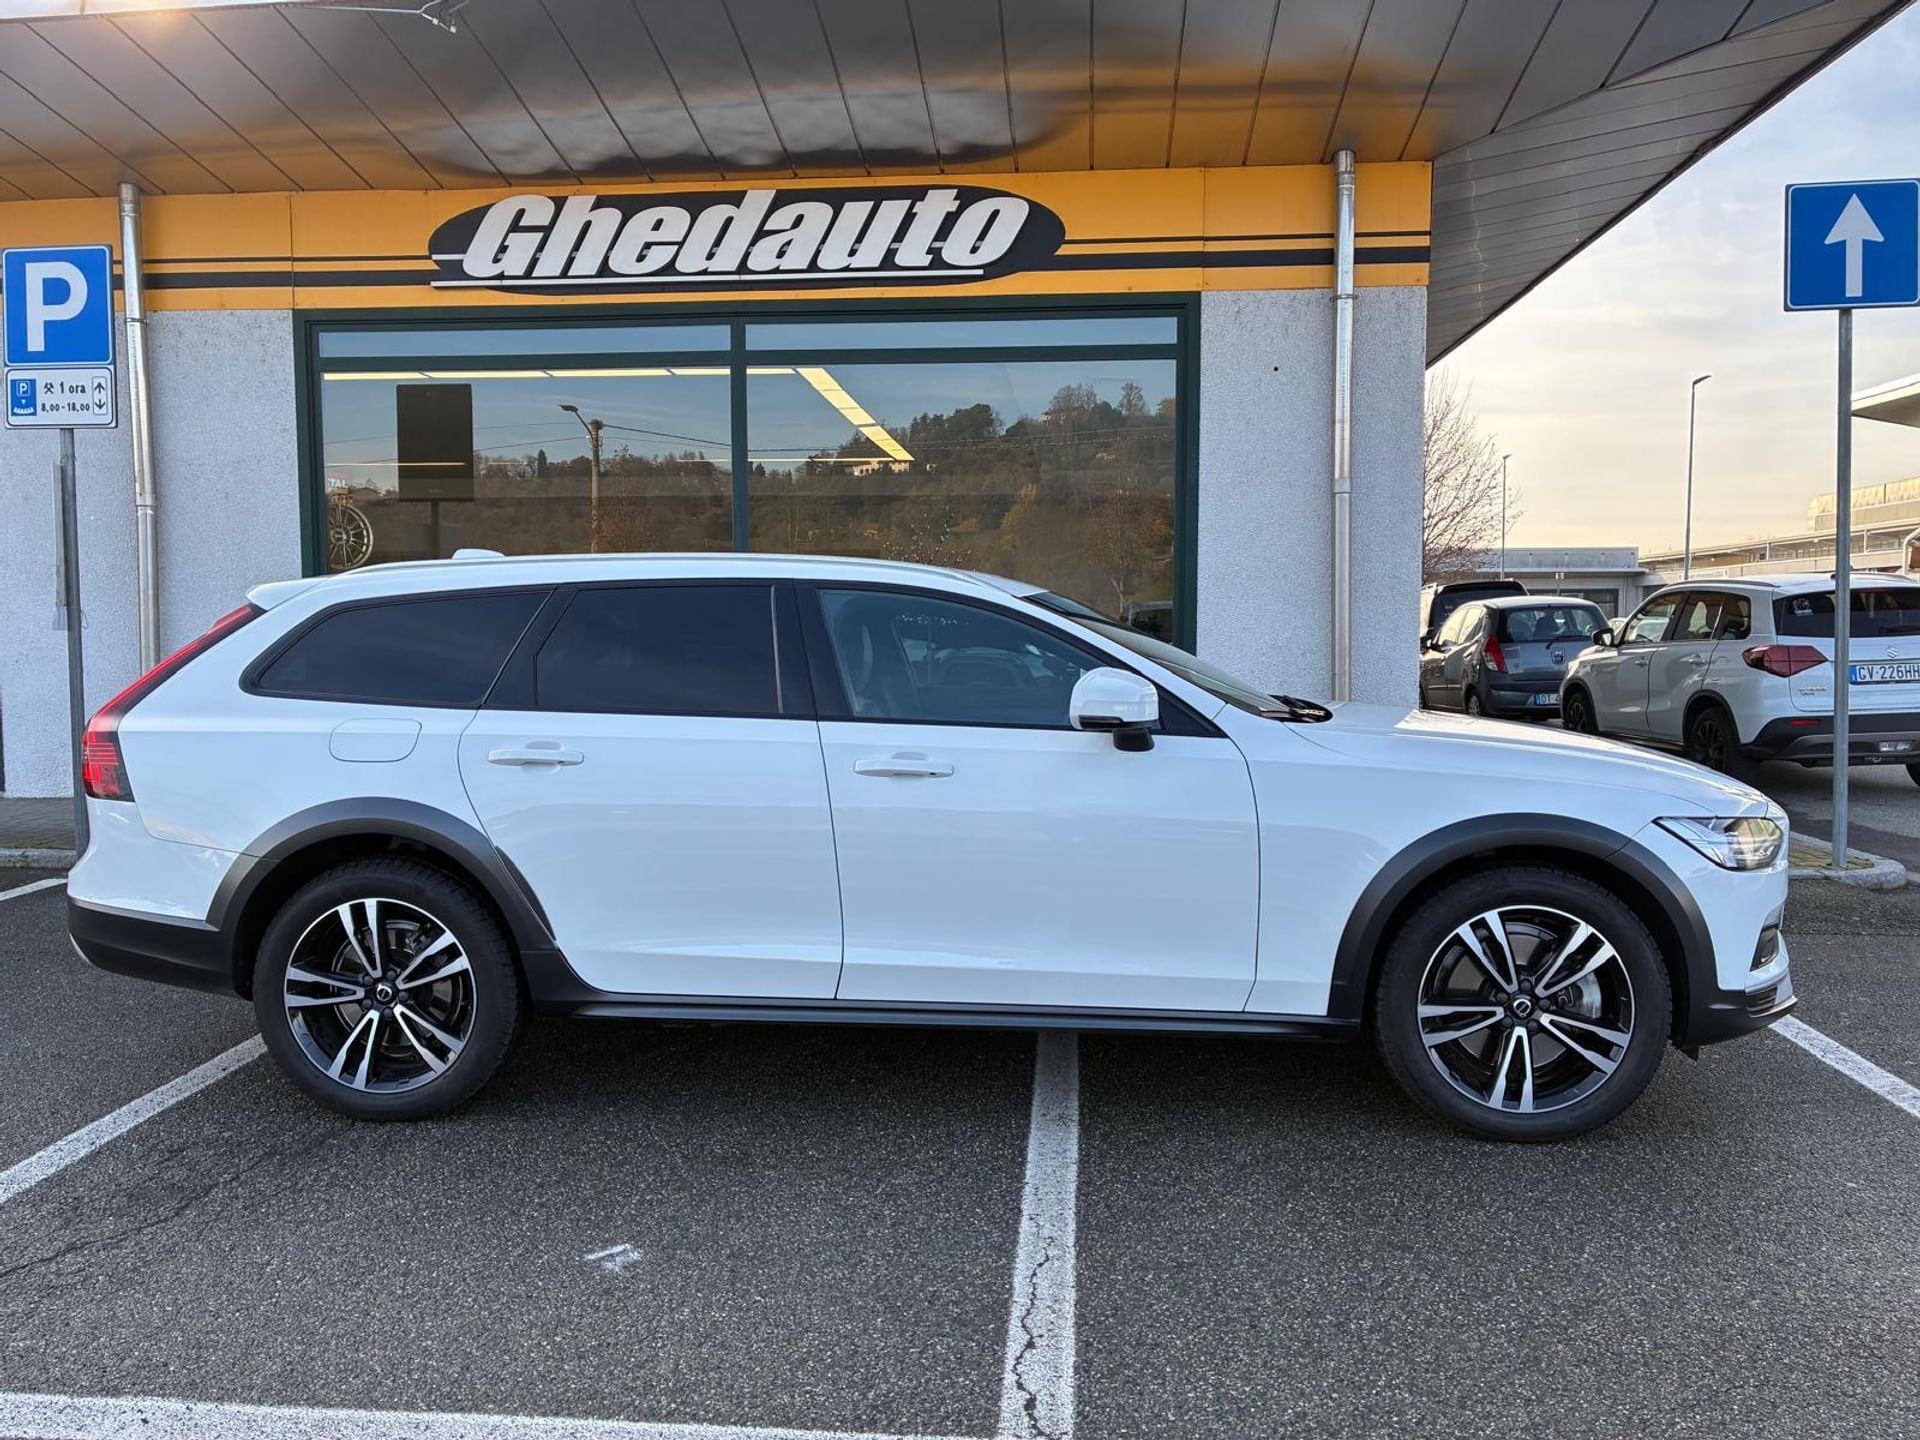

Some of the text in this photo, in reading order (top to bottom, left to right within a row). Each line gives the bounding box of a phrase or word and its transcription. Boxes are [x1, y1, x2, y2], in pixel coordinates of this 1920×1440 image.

[461, 188, 1030, 278] Ghedauto
[25, 261, 88, 352] P
[20, 383, 28, 395] P
[60, 381, 87, 394] 1 ora
